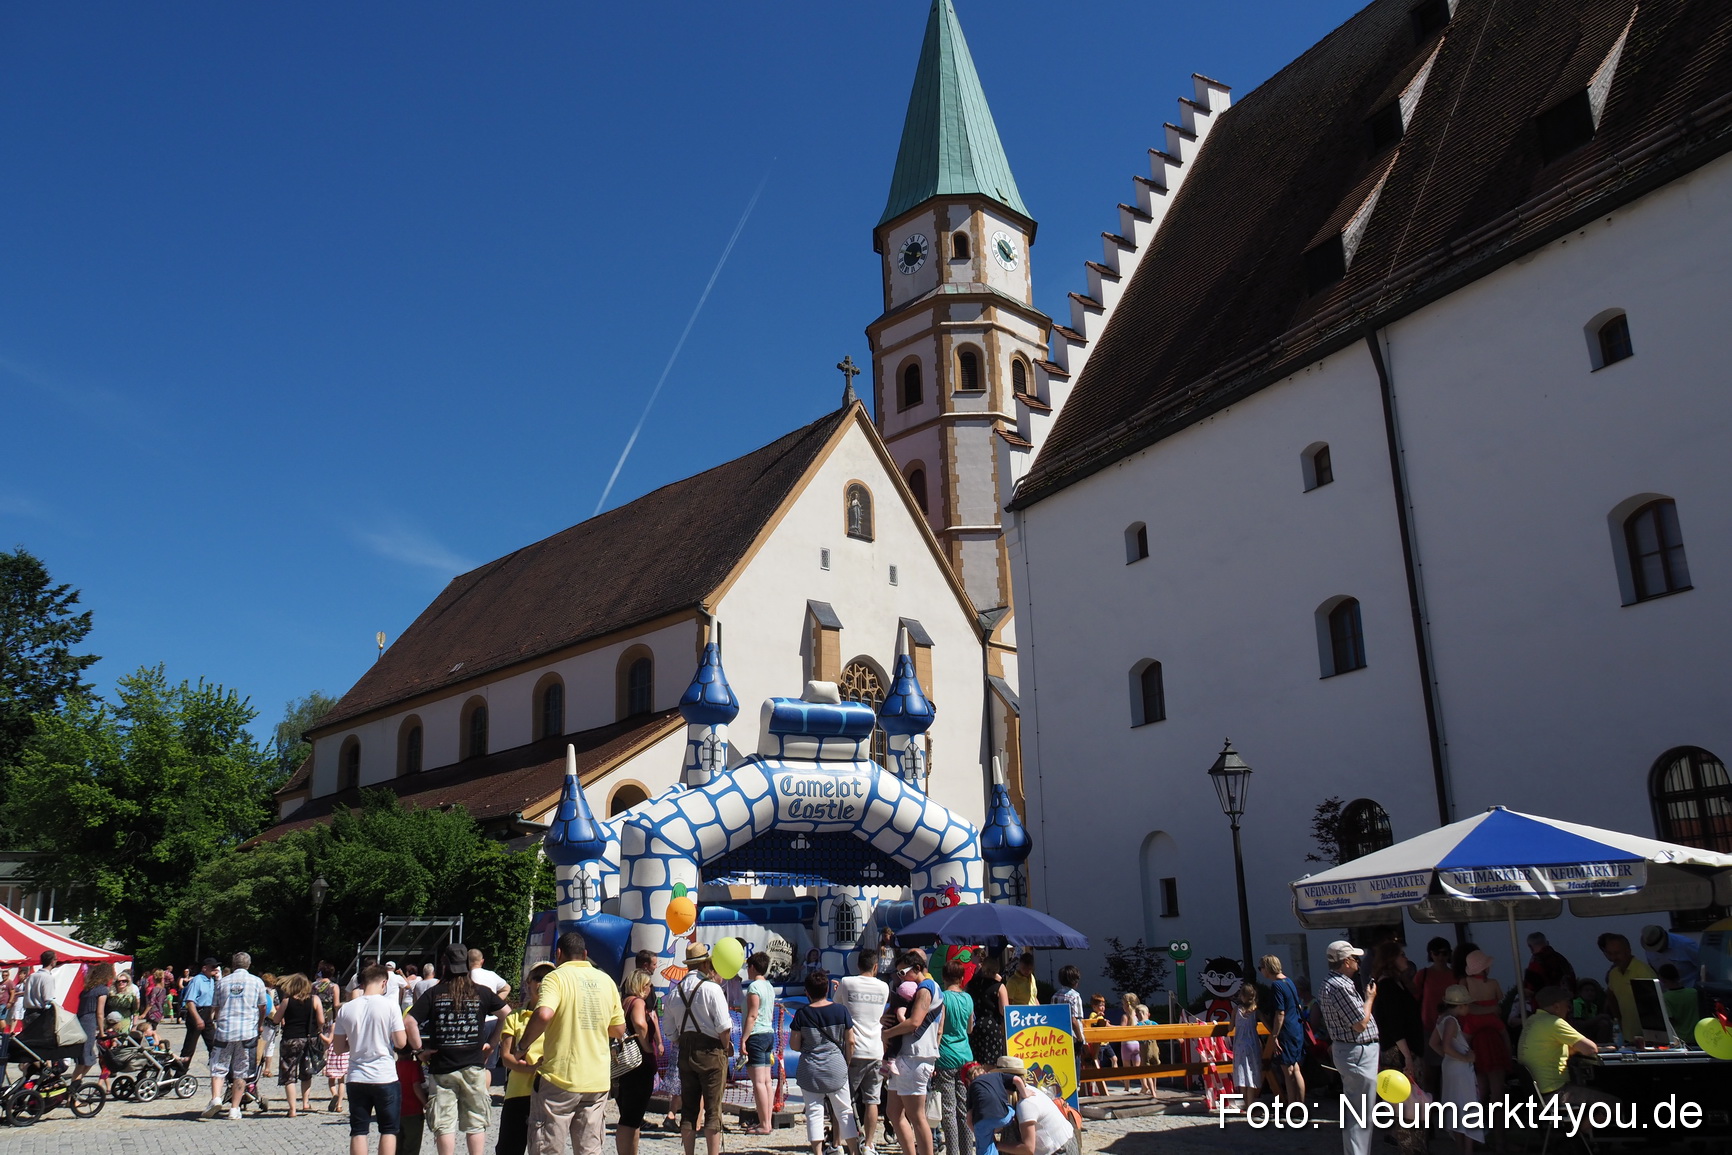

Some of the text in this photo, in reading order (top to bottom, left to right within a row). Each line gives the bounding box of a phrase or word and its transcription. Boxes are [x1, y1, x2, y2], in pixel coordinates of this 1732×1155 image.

[780, 775, 864, 799] Camelot
[788, 798, 855, 820] Castle
[1453, 868, 1533, 885] NEUMARKTER
[1549, 864, 1633, 880] NEUMARKTER
[1304, 882, 1357, 899] NEUMARKTER
[1369, 874, 1426, 892] NEUMARKTER
[1009, 1010, 1049, 1028] Bitte
[1013, 1029, 1065, 1050] Schuhe
[1013, 1045, 1068, 1060] ausziehen
